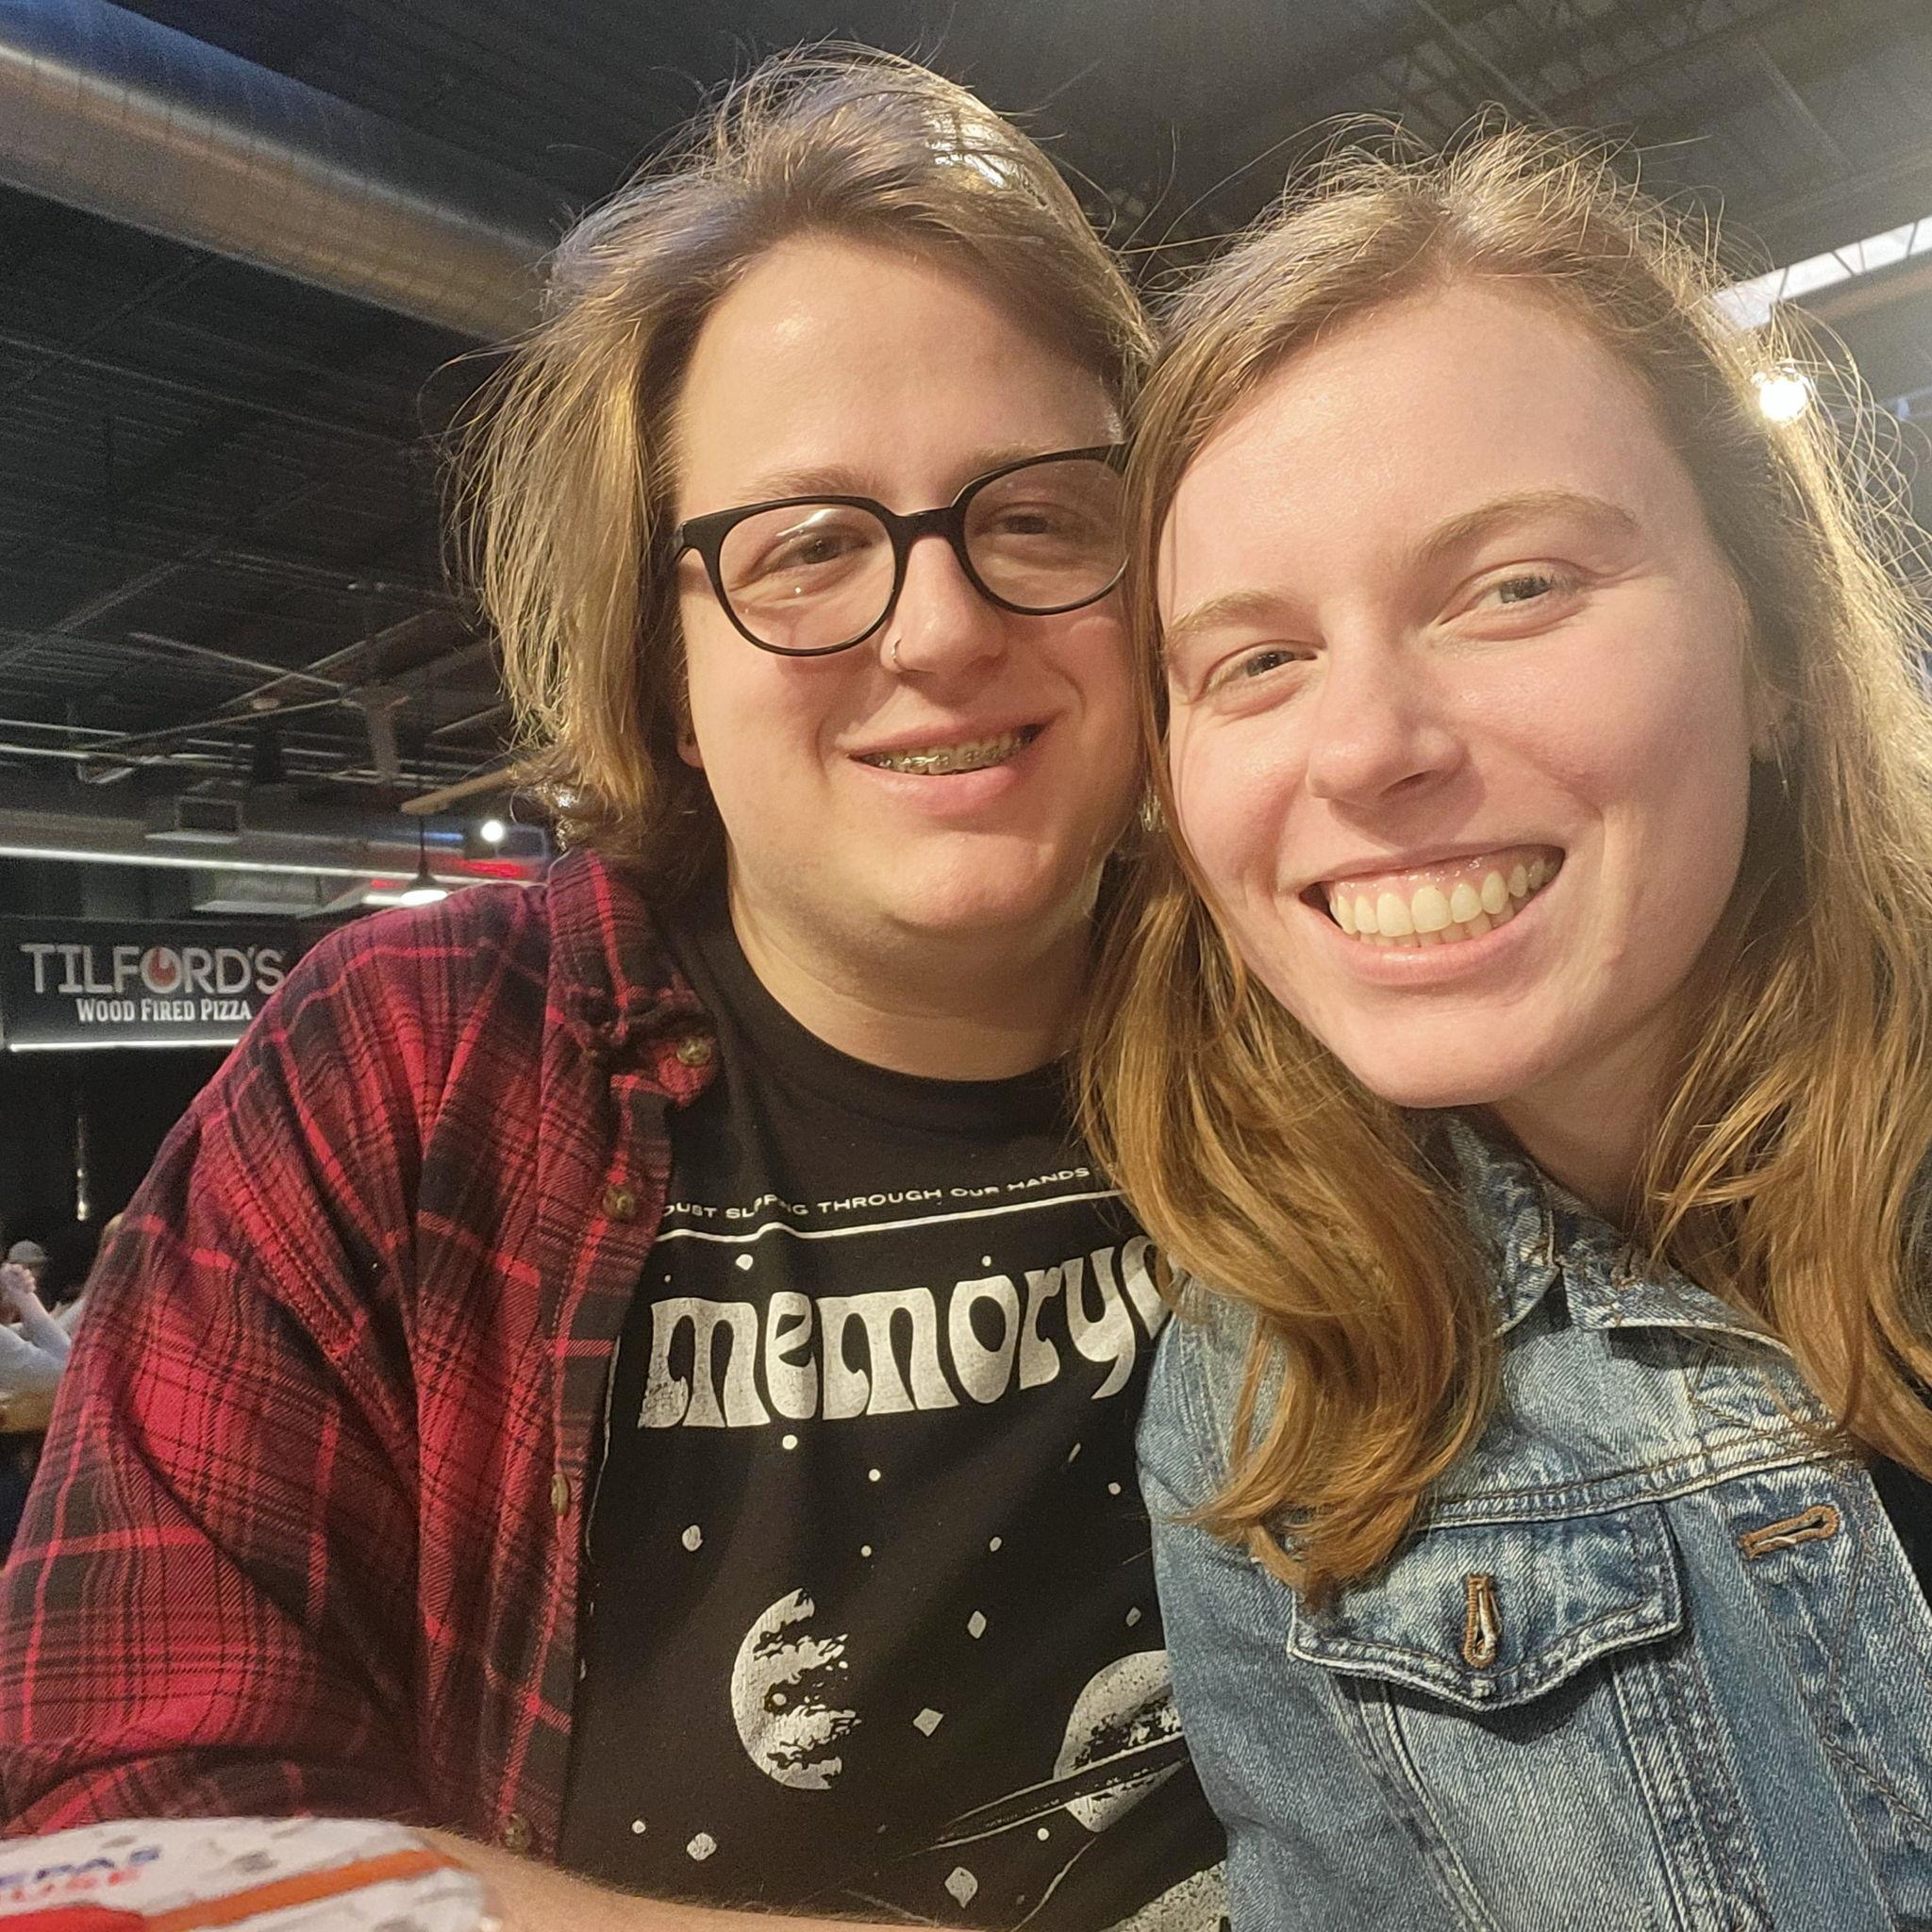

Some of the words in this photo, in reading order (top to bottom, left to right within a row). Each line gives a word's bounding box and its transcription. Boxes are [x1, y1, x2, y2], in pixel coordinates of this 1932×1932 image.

[20, 943, 286, 994] TILFORD'S
[76, 997, 135, 1022] WOOD
[141, 998, 195, 1022] FIRED
[201, 998, 252, 1022] PIZZA
[817, 1189, 942, 1213] THROUGH
[950, 1186, 1000, 1197] OUR
[1007, 1167, 1091, 1191] HANDS
